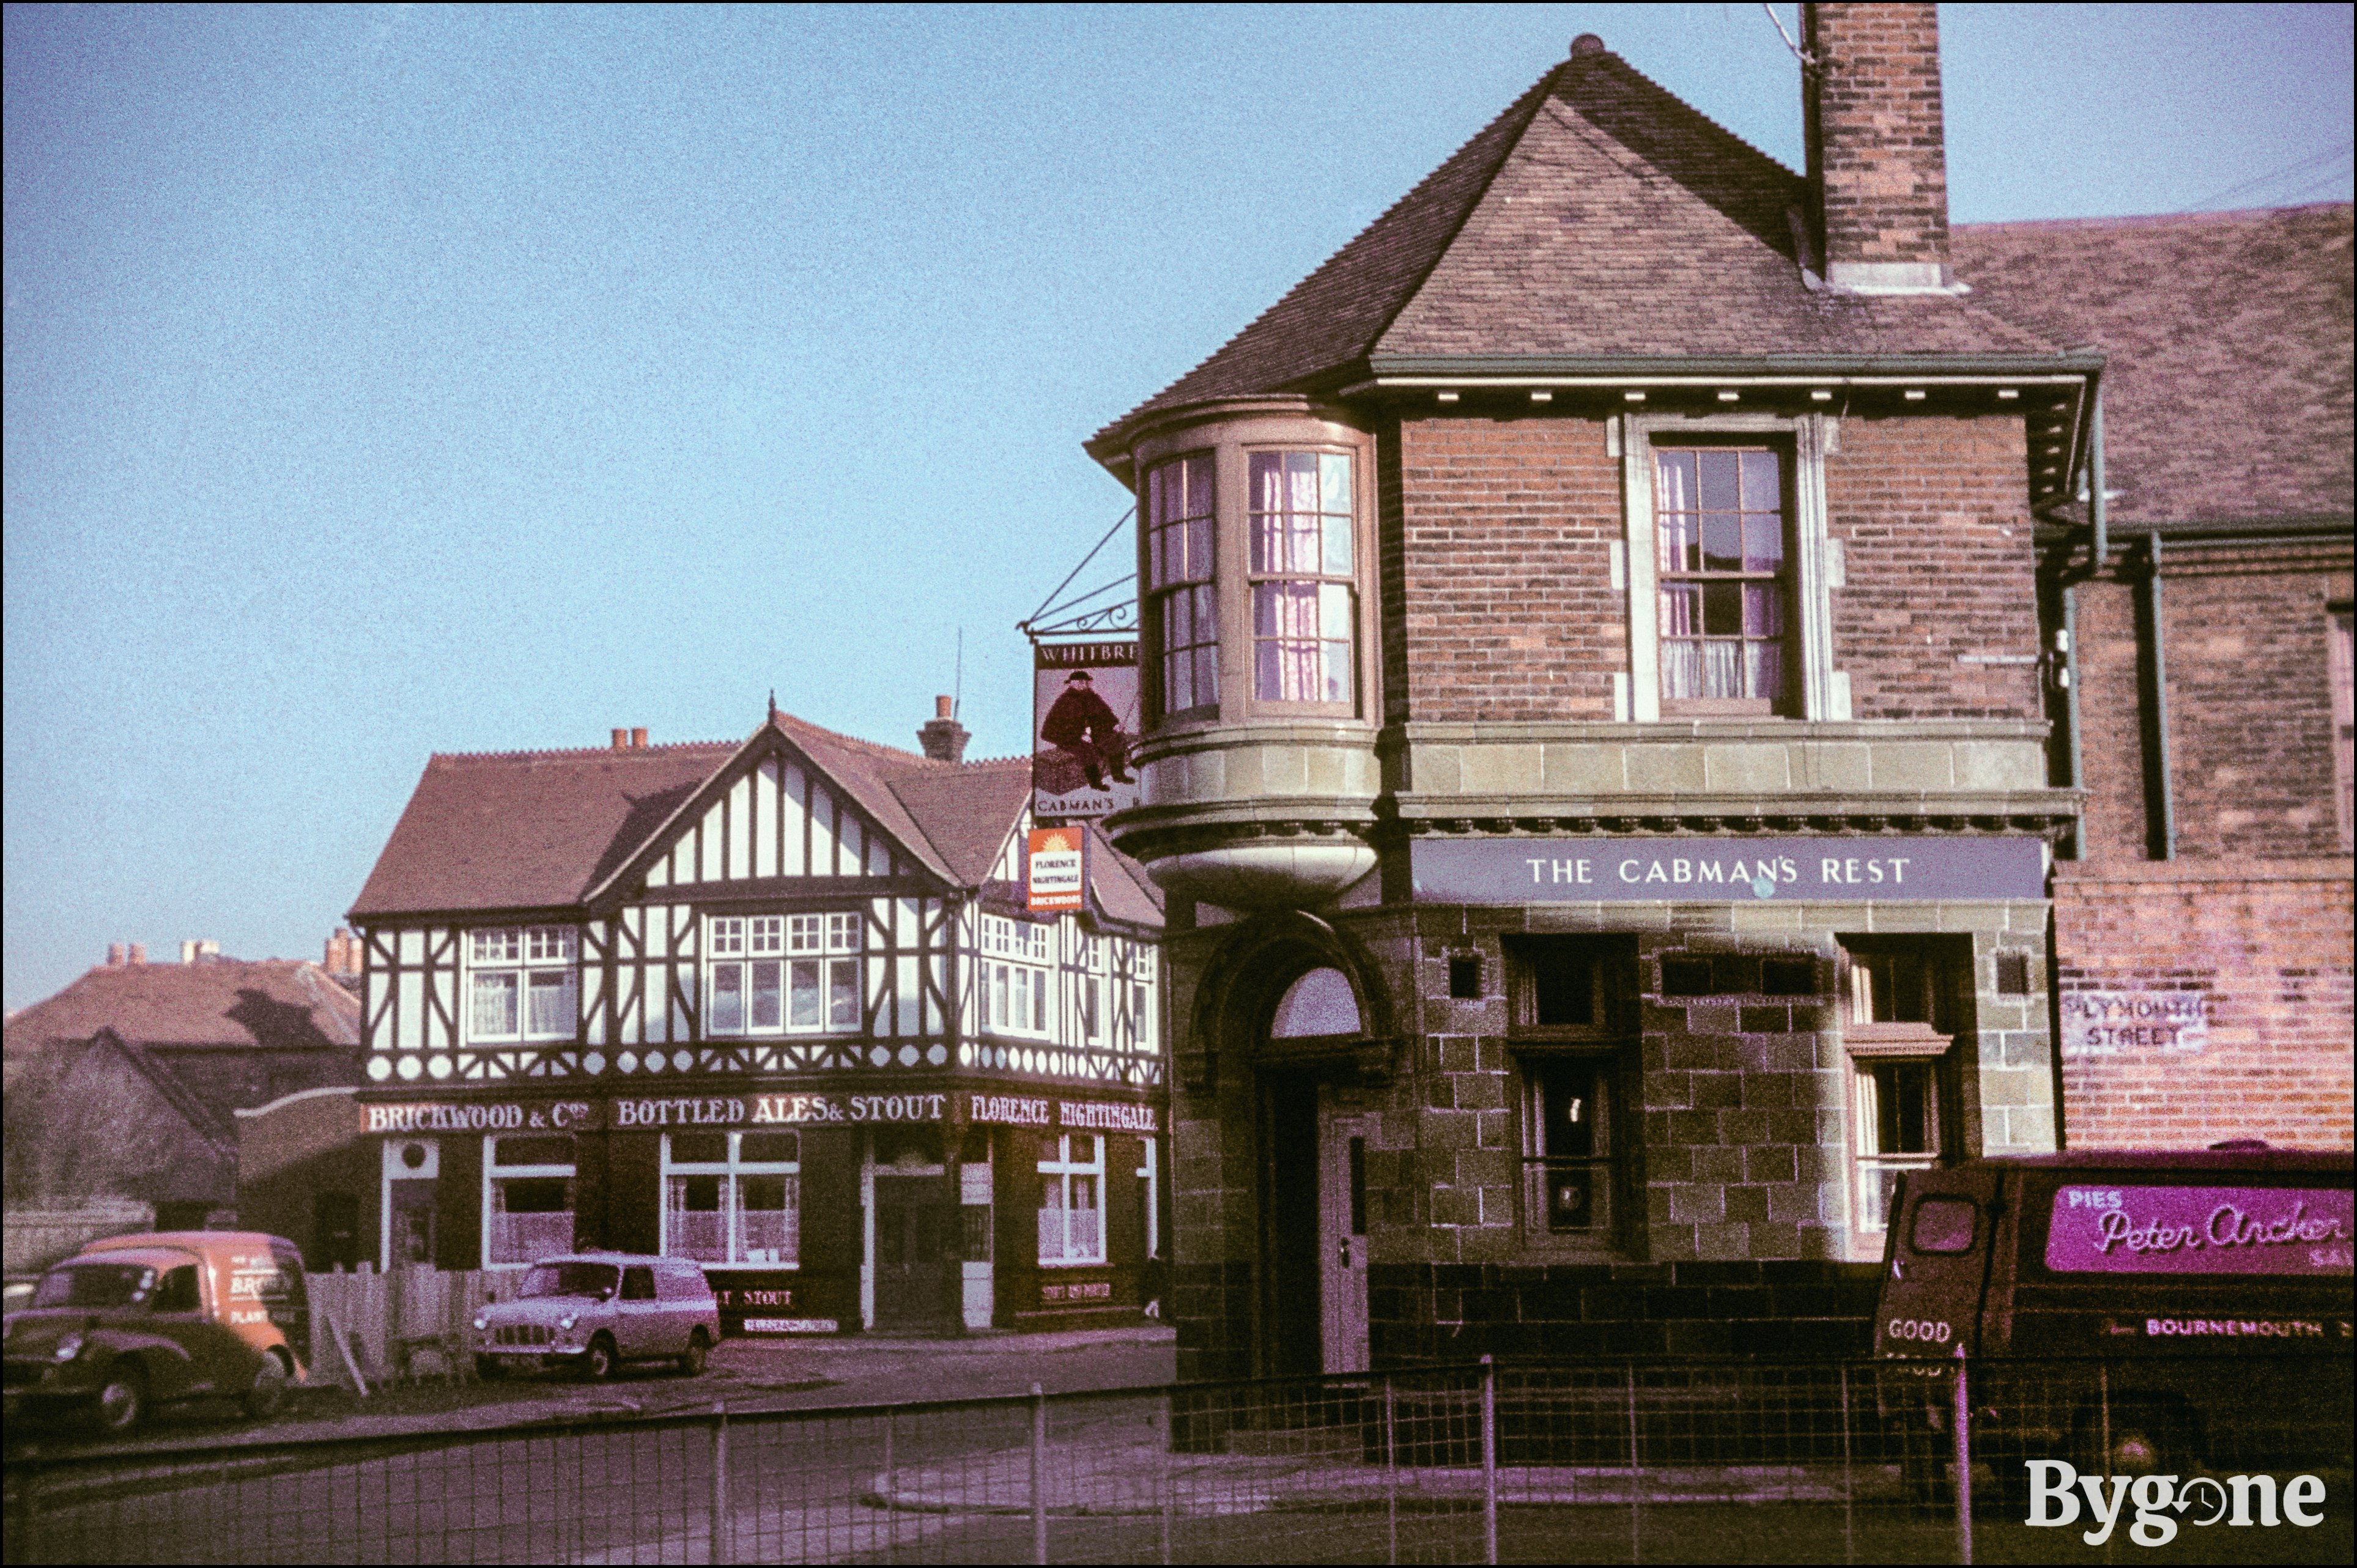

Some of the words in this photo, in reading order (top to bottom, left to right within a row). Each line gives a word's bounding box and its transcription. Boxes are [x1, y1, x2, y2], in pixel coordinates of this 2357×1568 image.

[1035, 859, 1076, 869] FLORENCE
[1527, 859, 1593, 883] THE
[1619, 856, 1797, 884] CABMAN'S
[1822, 858, 1910, 884] REST
[1032, 874, 1079, 884] NIGHTINGALE
[2087, 1026, 2180, 1046] STREET
[369, 1104, 523, 1132] BRICKWOOD
[528, 1110, 547, 1129] &
[617, 1098, 746, 1125] BOTTLED
[752, 1095, 827, 1123] ALES
[850, 1093, 946, 1120] STOUT
[971, 1095, 1050, 1124] FLORENCE
[1059, 1101, 1159, 1131] NIGHTINGALE
[2068, 1191, 2122, 1209] PIES
[2093, 1208, 2202, 1253] Peter
[743, 1290, 791, 1306] STOUT
[1889, 1317, 1951, 1344] GOOD
[2145, 1318, 2322, 1337] BOURNEMOUTH
